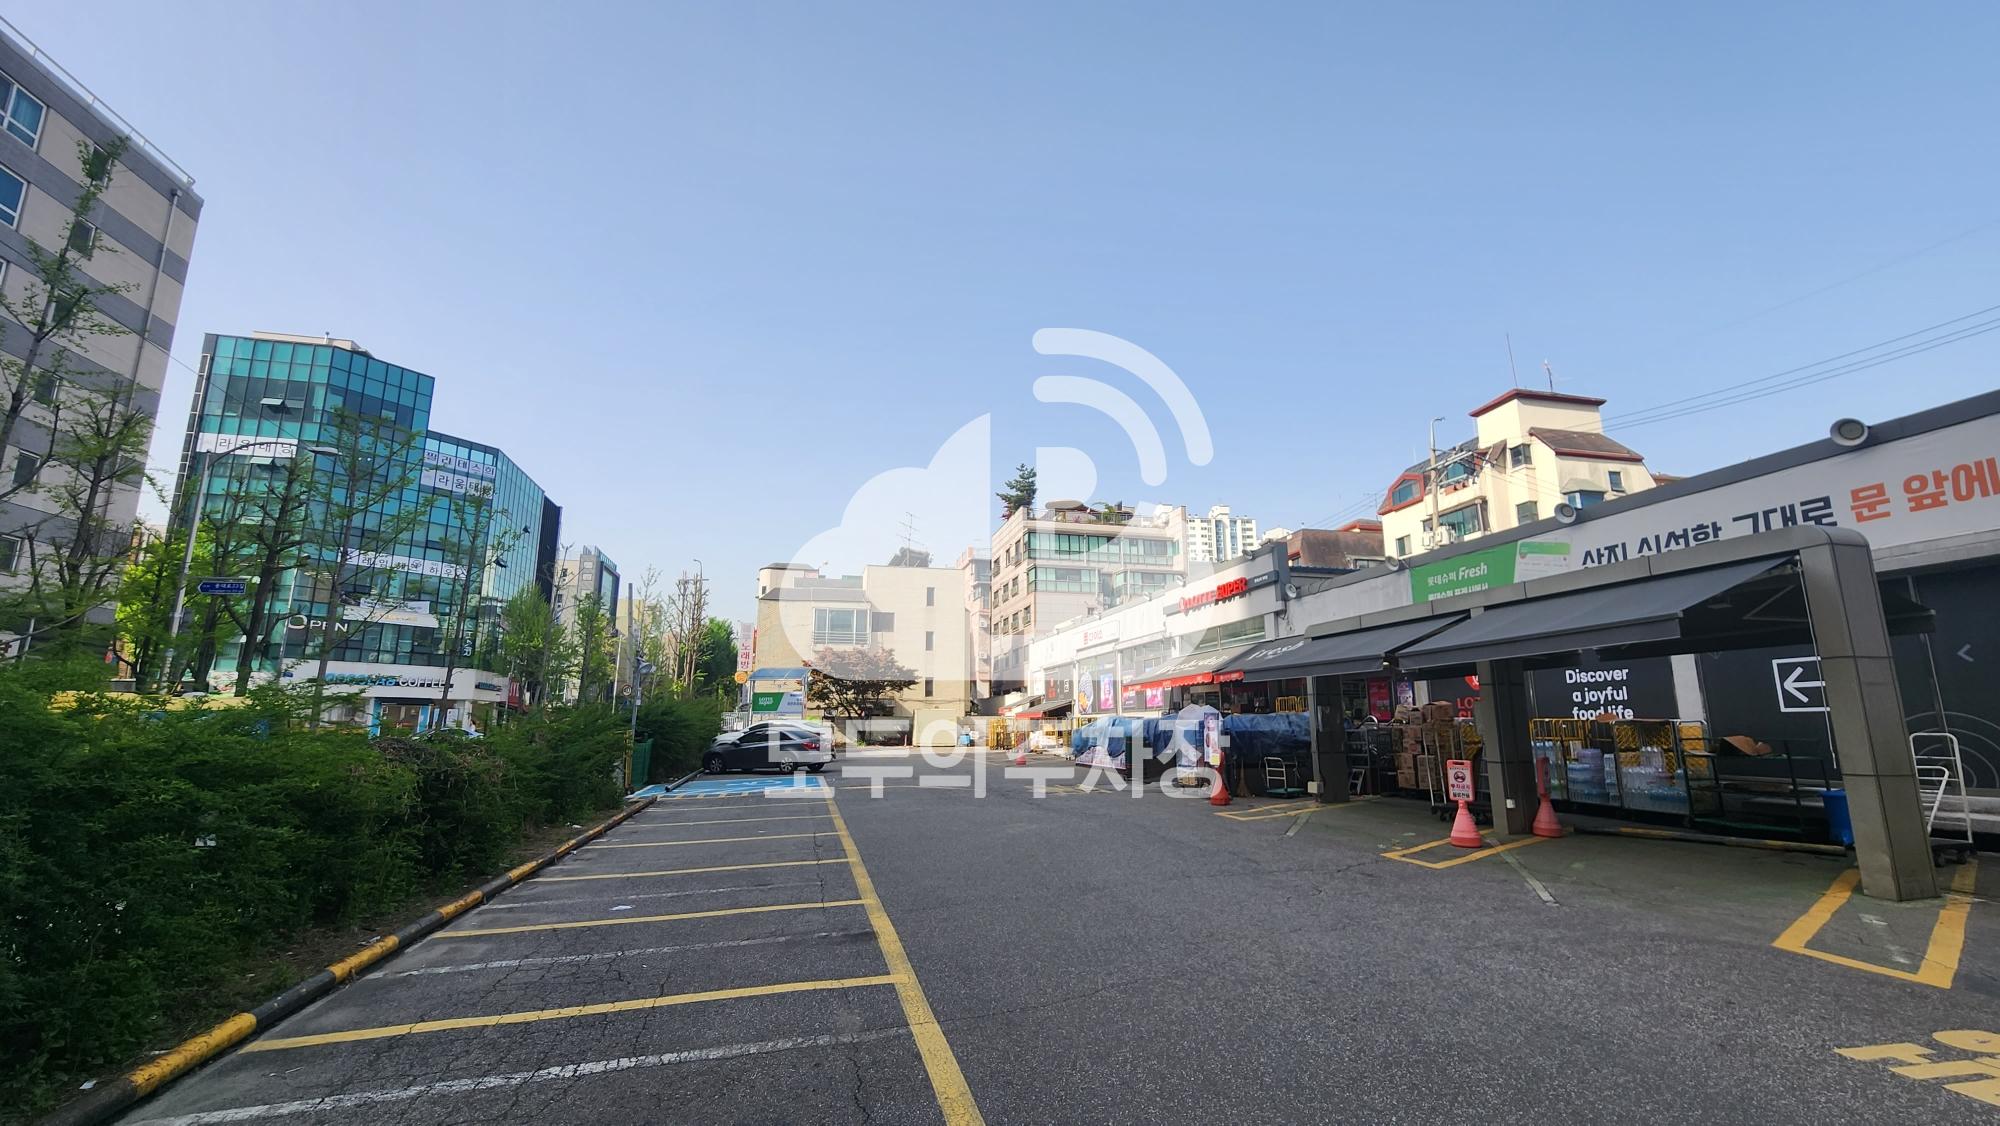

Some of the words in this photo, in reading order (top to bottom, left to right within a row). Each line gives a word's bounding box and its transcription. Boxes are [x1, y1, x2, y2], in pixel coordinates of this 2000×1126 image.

[1731, 495, 1839, 535] 그대로
[1849, 482, 1892, 523] 문
[1902, 457, 2000, 513] 앞에
[1458, 562, 1488, 581] Fresh
[1216, 577, 1249, 599] SUPER
[740, 642, 751, 670] 노래방
[1565, 668, 1629, 684] Discover
[1572, 691, 1582, 702] a
[1583, 685, 1628, 705] joyful
[1571, 705, 1605, 721] food
